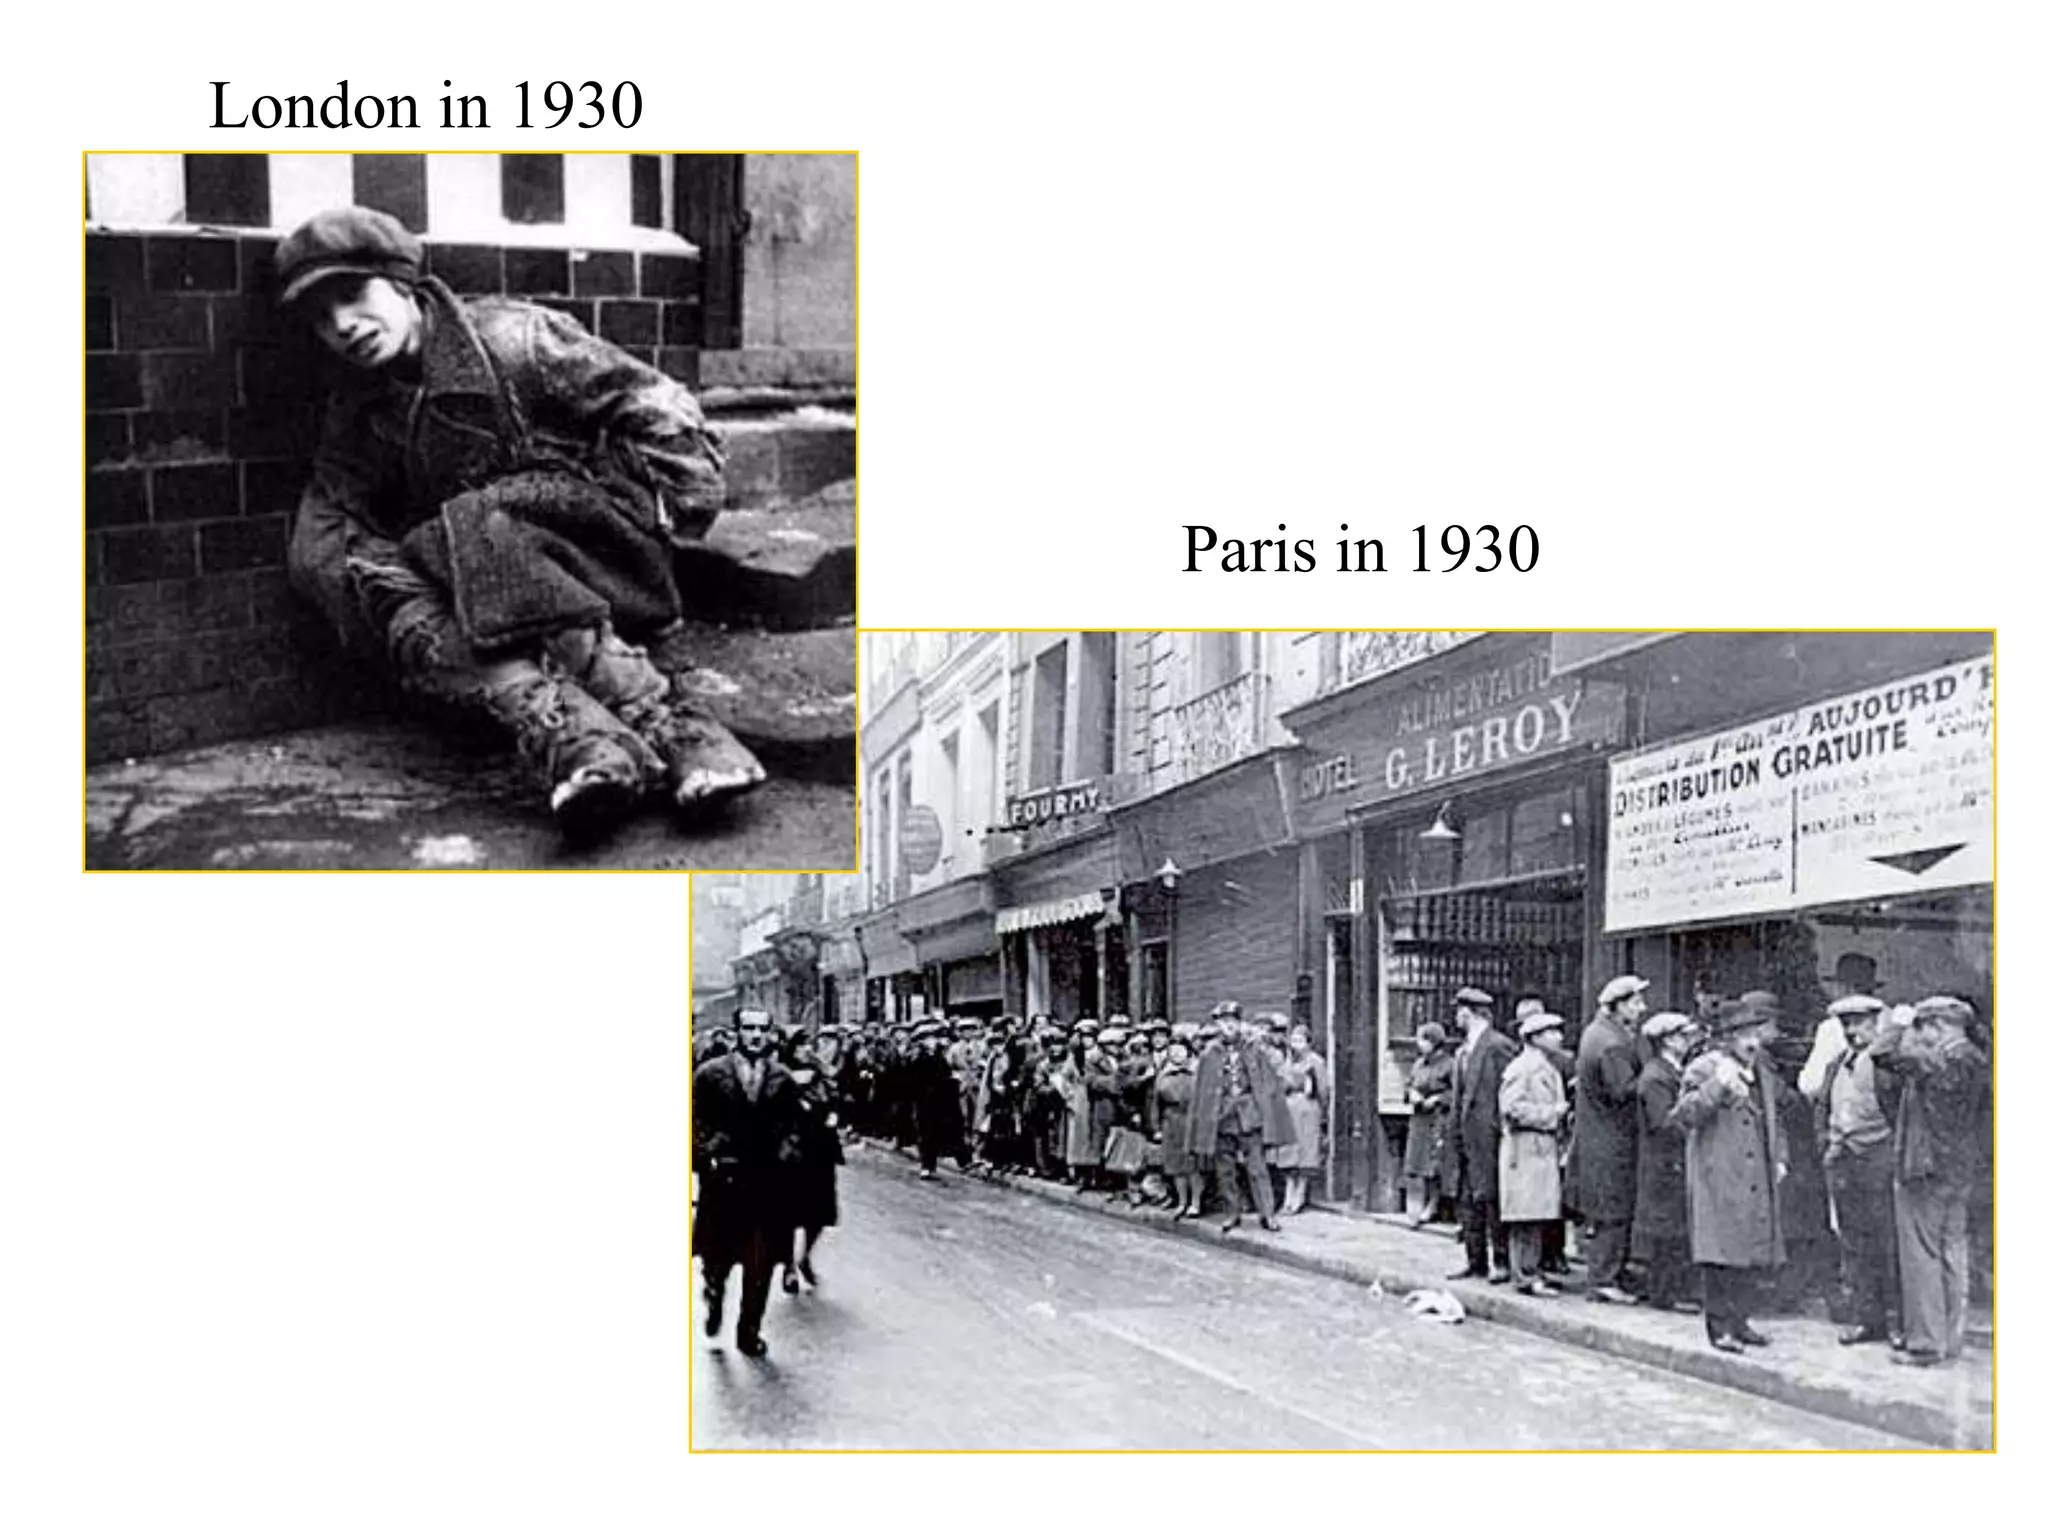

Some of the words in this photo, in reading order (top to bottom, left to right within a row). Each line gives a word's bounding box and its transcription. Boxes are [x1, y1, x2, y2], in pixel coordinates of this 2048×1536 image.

[1423, 688, 1586, 783] LEROY
[1613, 755, 1762, 818] DISTRIBUTION
[1771, 719, 1909, 780] GRATUITE
[1010, 786, 1100, 825] FOURMY
